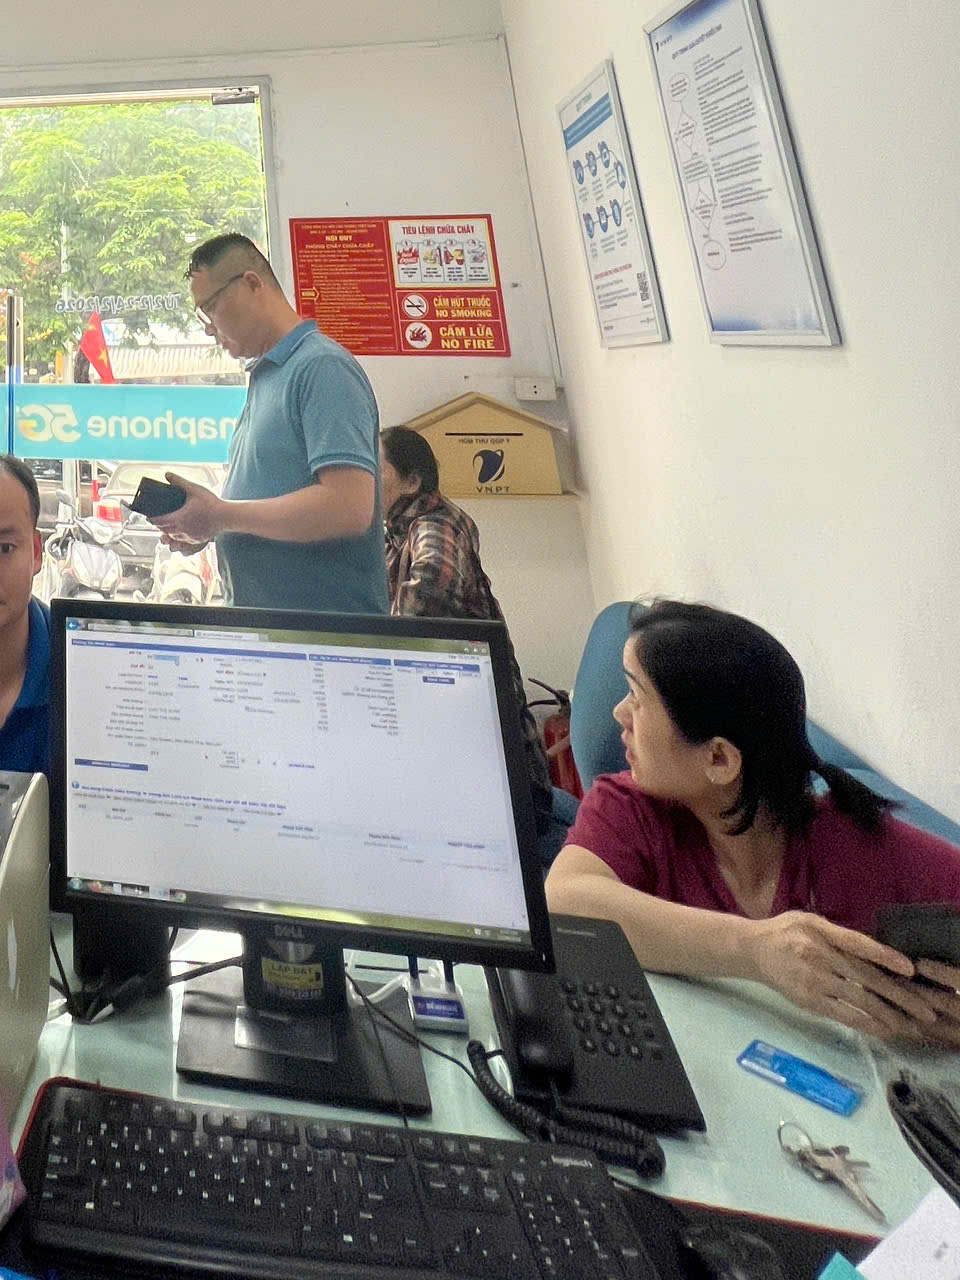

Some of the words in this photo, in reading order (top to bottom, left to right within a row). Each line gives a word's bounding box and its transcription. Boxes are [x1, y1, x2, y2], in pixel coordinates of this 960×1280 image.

[418, 224, 435, 236] LỆNH
[437, 223, 456, 234] CHỮA
[457, 224, 475, 234] CHÁY
[433, 295, 449, 307] CẤM
[450, 295, 465, 307] HÚT
[466, 295, 491, 307] THUỐC
[435, 309, 448, 318] NO
[450, 309, 492, 318] SMOKING
[439, 323, 466, 337] CẤM
[469, 323, 493, 337] LỬA
[441, 339, 460, 349] NO
[464, 339, 496, 349] FIRE
